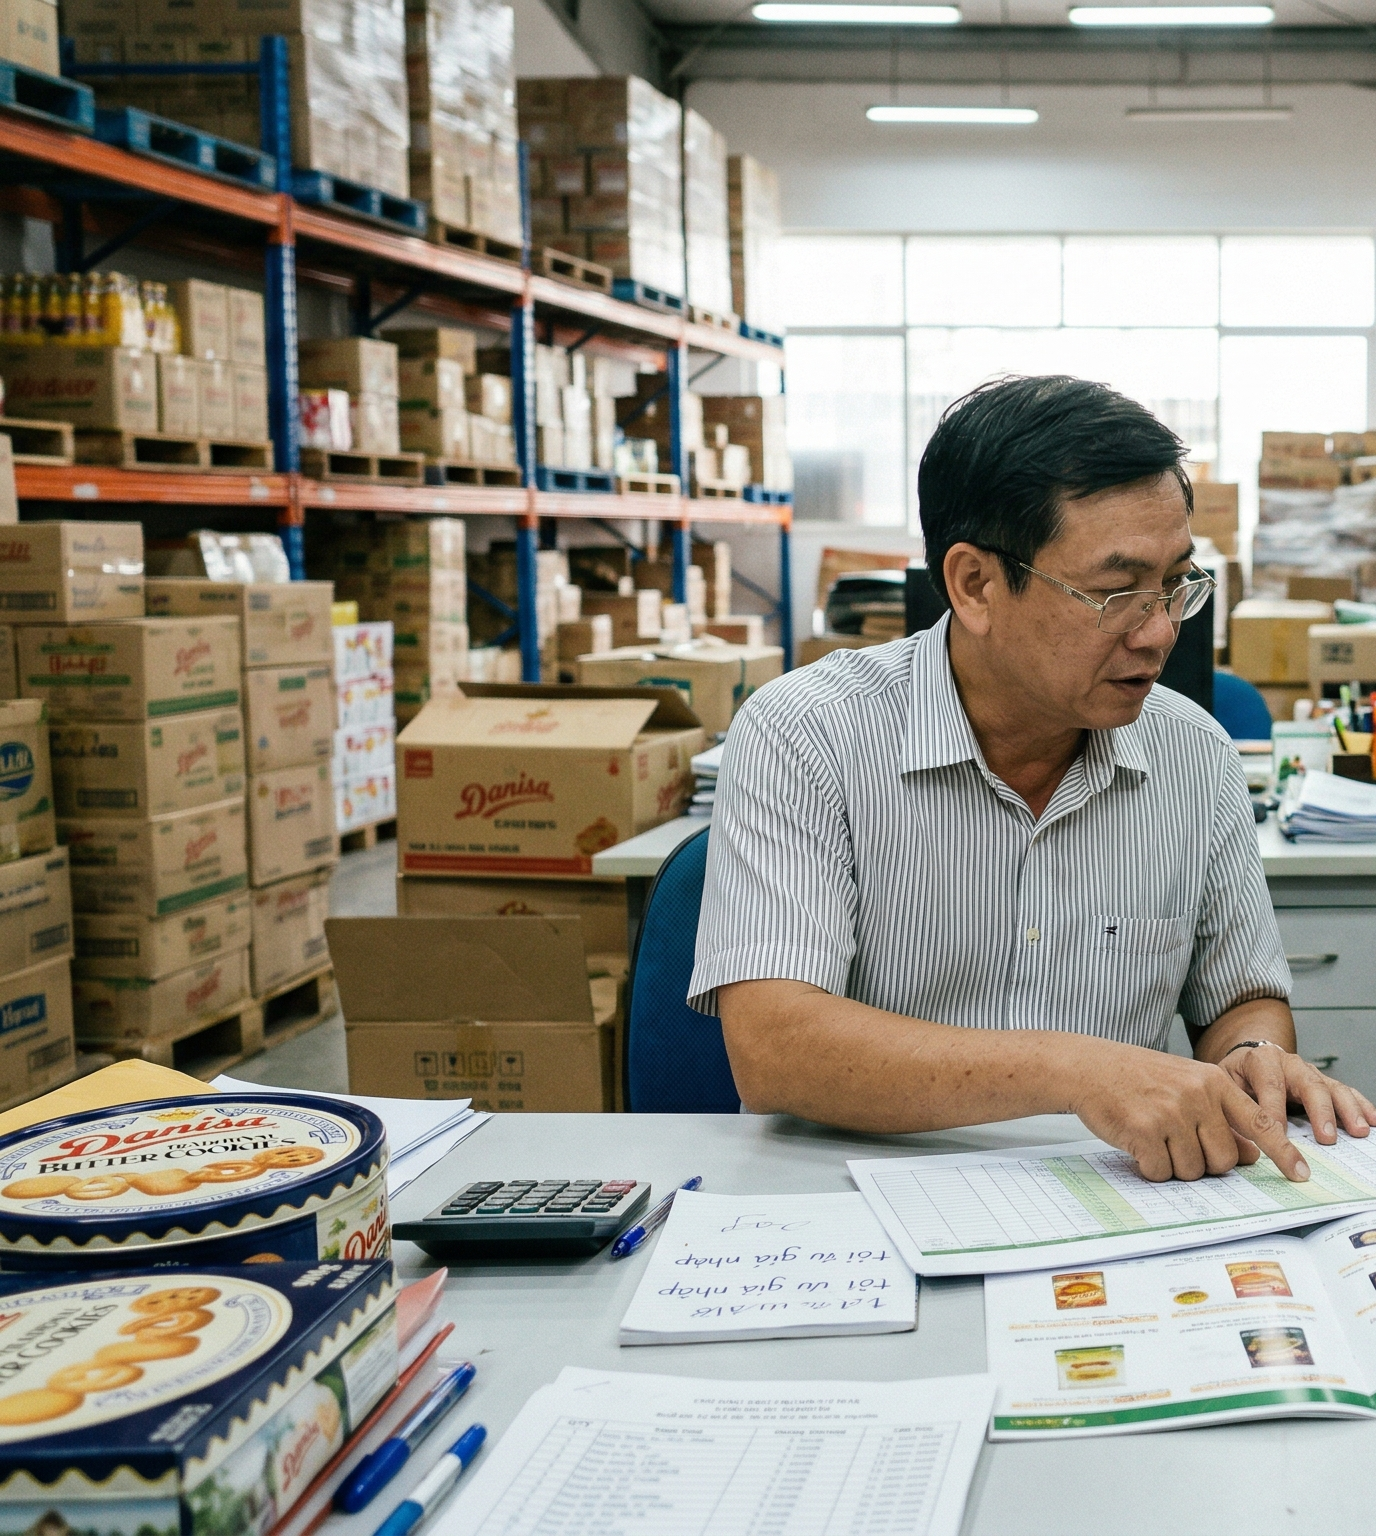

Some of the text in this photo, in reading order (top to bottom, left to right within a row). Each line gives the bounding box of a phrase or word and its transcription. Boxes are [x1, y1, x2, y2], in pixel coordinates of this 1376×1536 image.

[455, 771, 554, 820] Danisa
[38, 1138, 297, 1175] BUTTER COOKIES
[39, 1115, 276, 1163] Danisa
